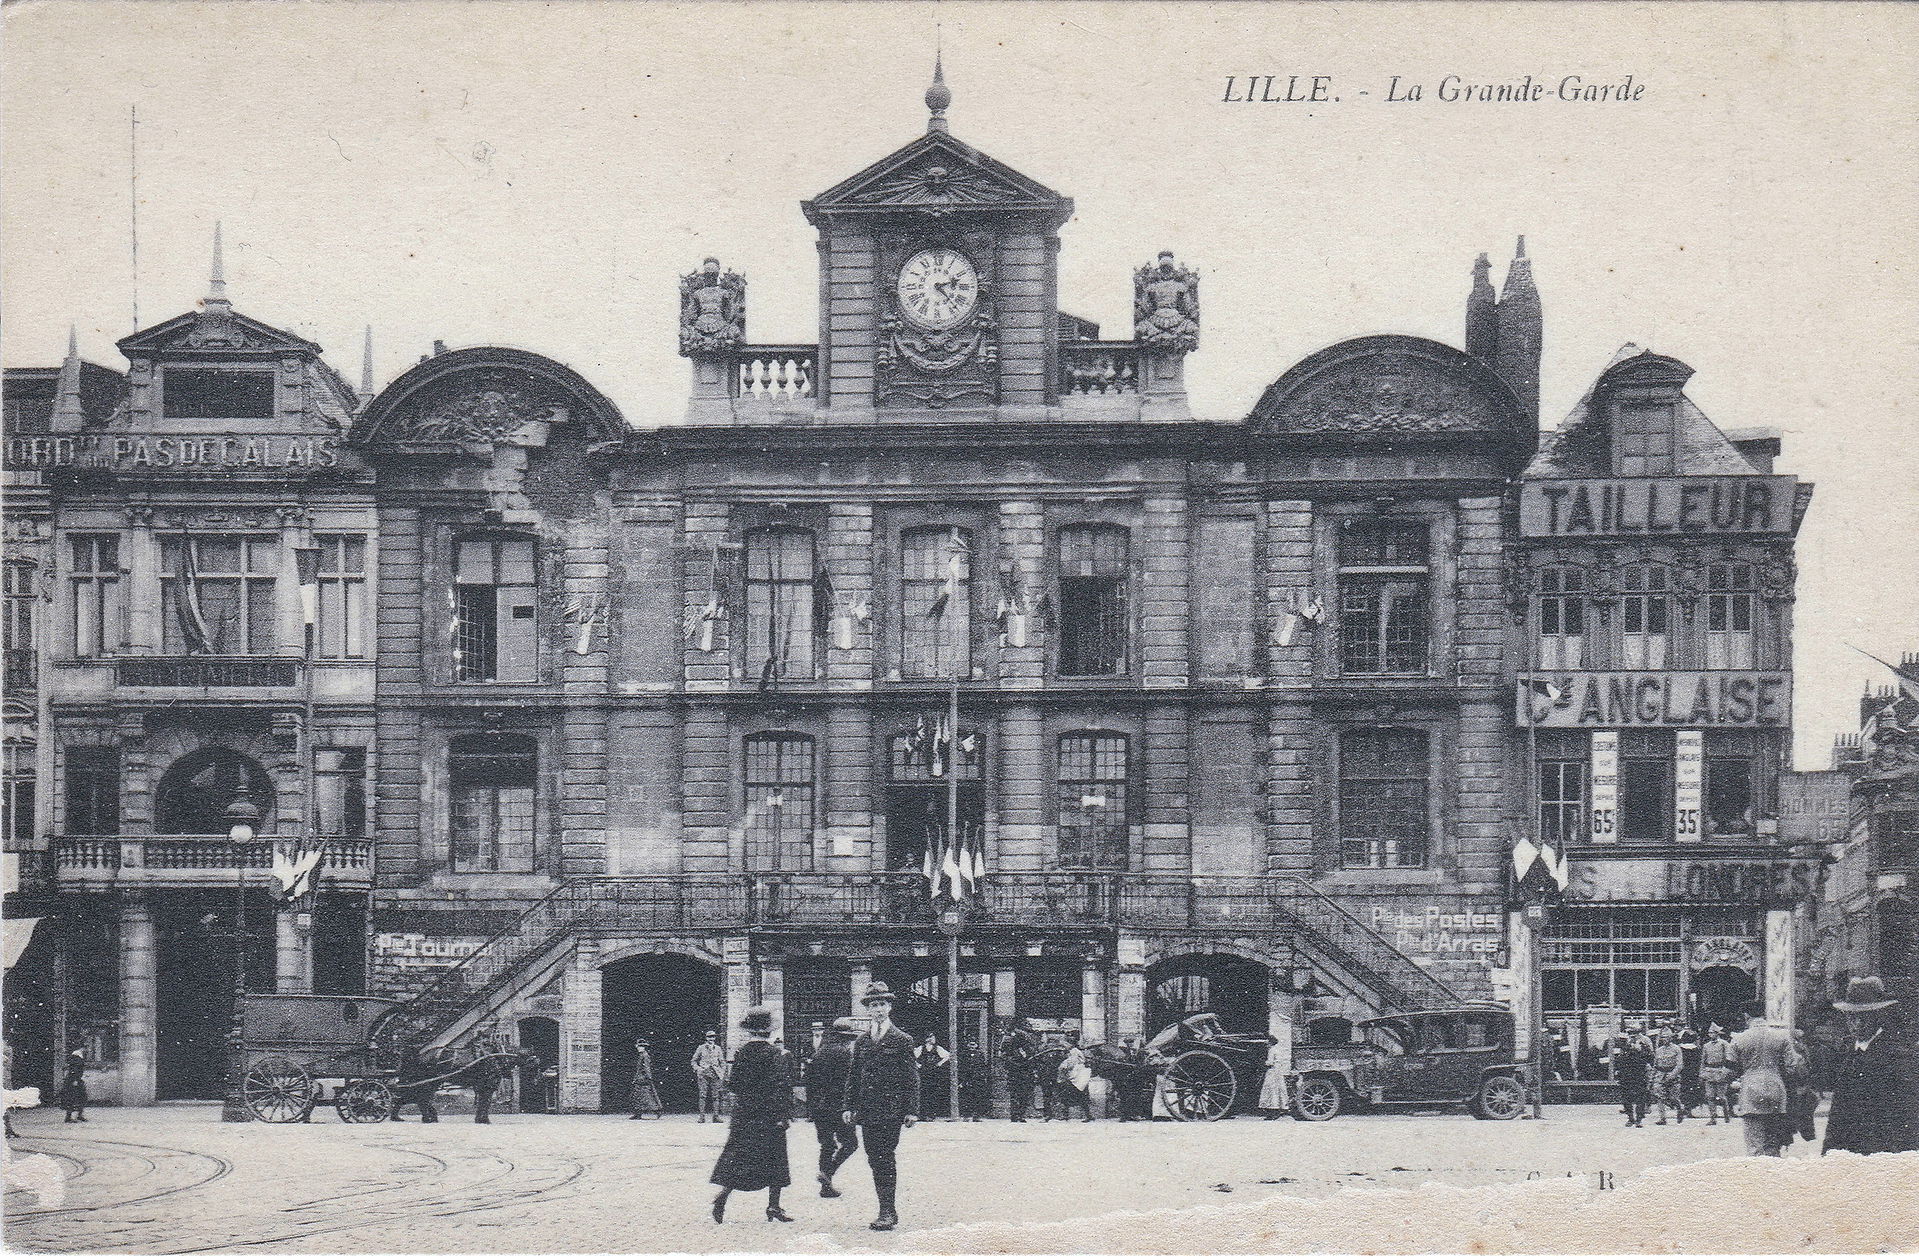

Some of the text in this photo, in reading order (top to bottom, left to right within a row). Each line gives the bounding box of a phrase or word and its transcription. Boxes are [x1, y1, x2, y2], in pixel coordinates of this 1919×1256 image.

[222, 437, 338, 467] CALAIS
[1542, 483, 1773, 531] TAILLEUR
[1578, 676, 1783, 724] ANGLAISE
[1426, 906, 1498, 928] Postes
